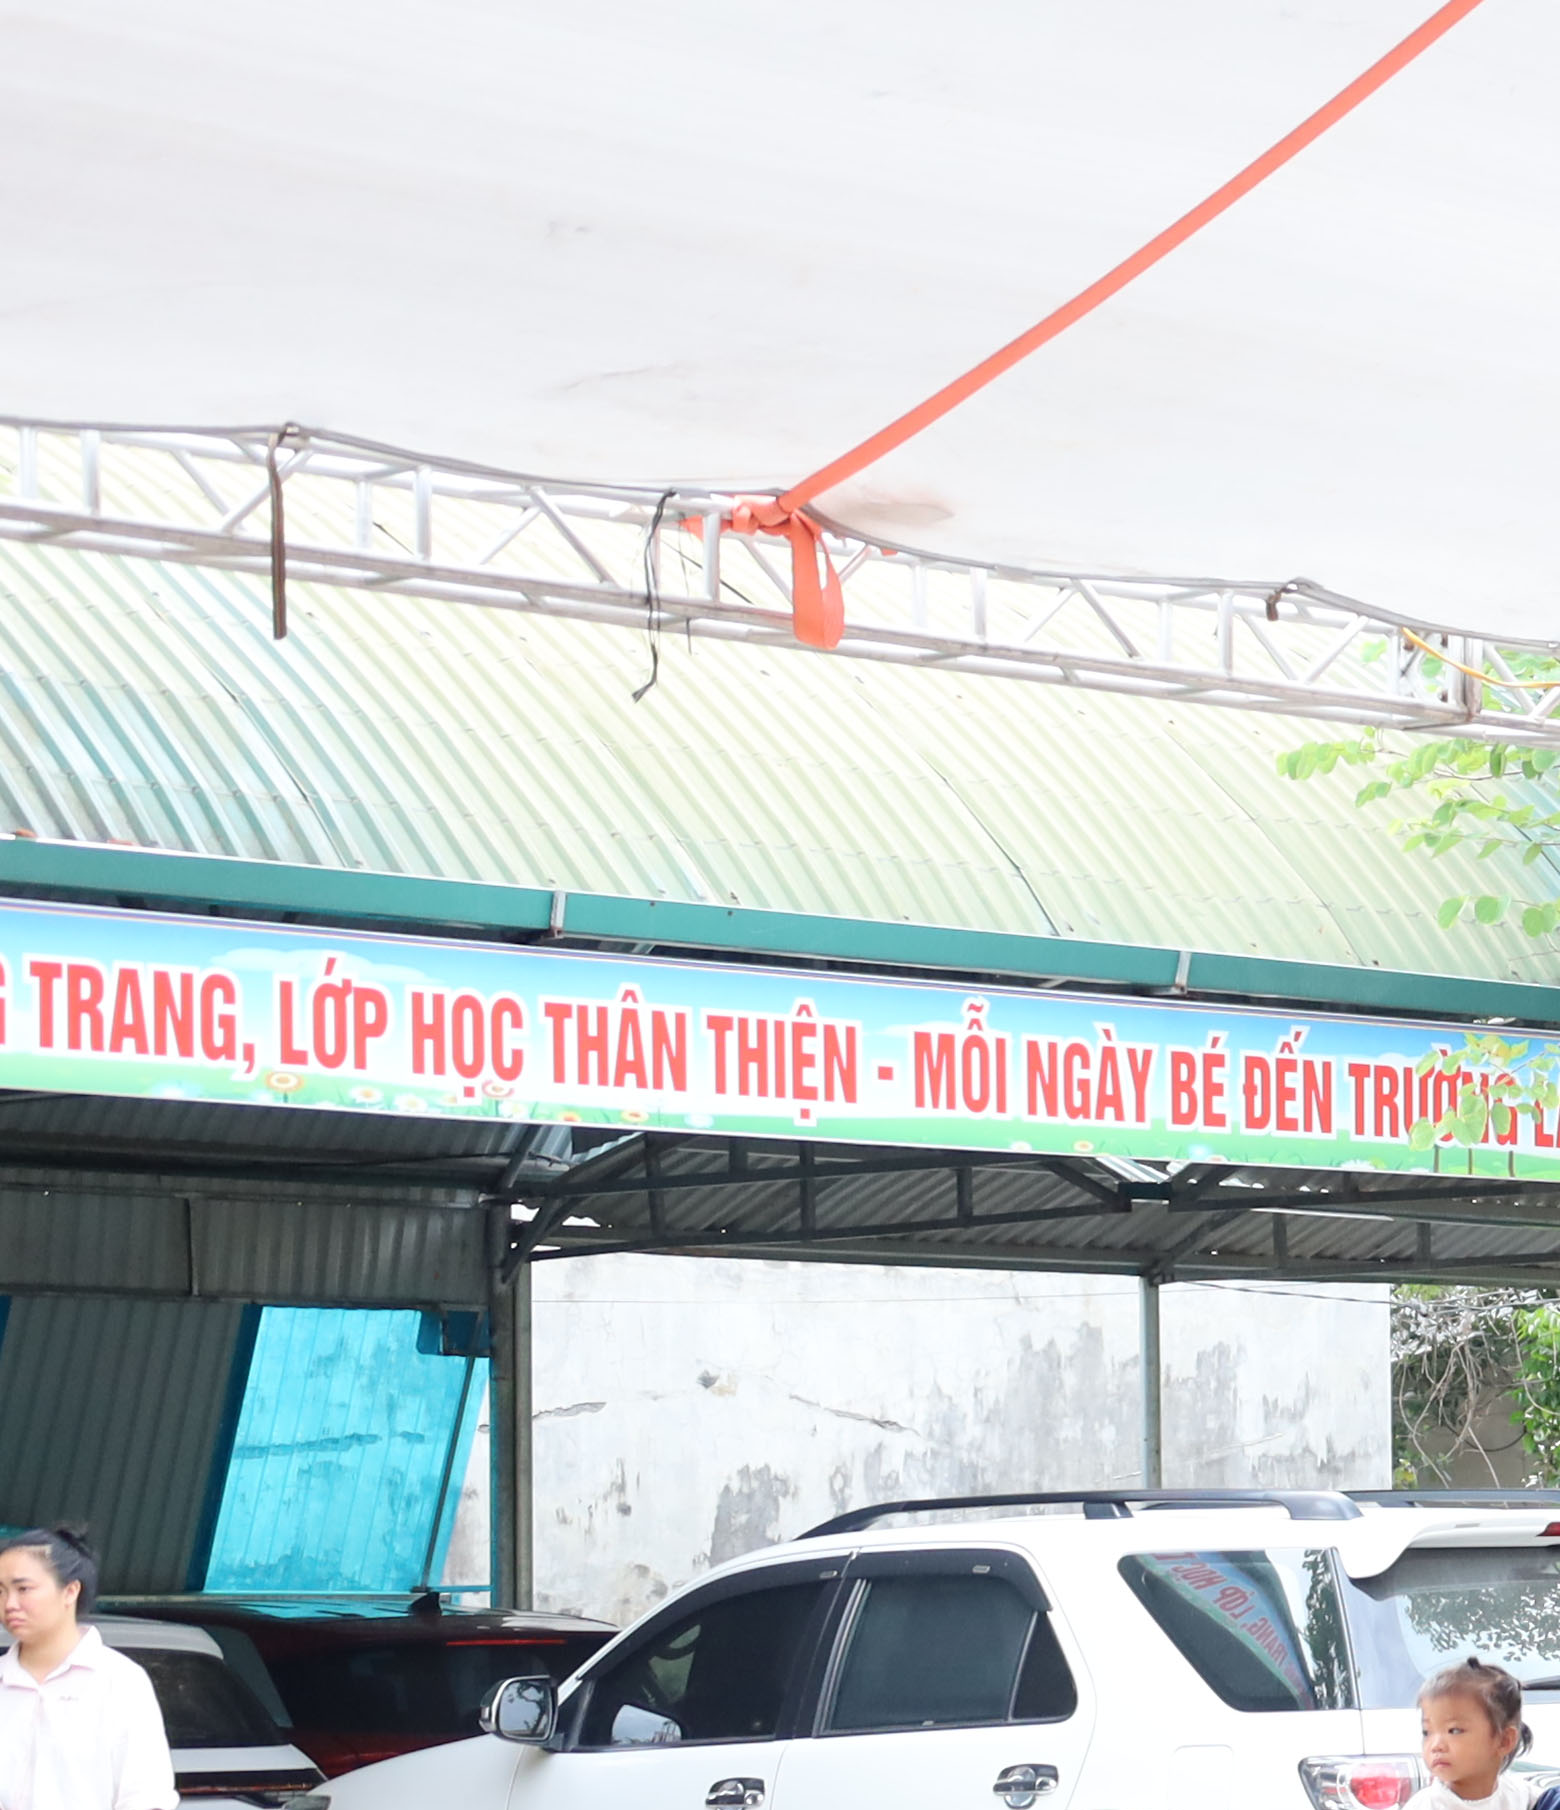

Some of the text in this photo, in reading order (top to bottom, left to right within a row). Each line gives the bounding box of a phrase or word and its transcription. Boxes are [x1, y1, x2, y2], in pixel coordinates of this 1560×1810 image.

[31, 962, 255, 1074] TRANG,
[280, 957, 388, 1069] LỚP
[413, 992, 524, 1097] HỌC
[545, 989, 686, 1091] THÂN
[708, 1005, 858, 1119] THIỆN
[915, 999, 1006, 1113] MỖI
[1027, 1025, 1153, 1123] NGÀY
[1172, 1036, 1226, 1127] BÉ
[1243, 1027, 1332, 1133] ĐẾN
